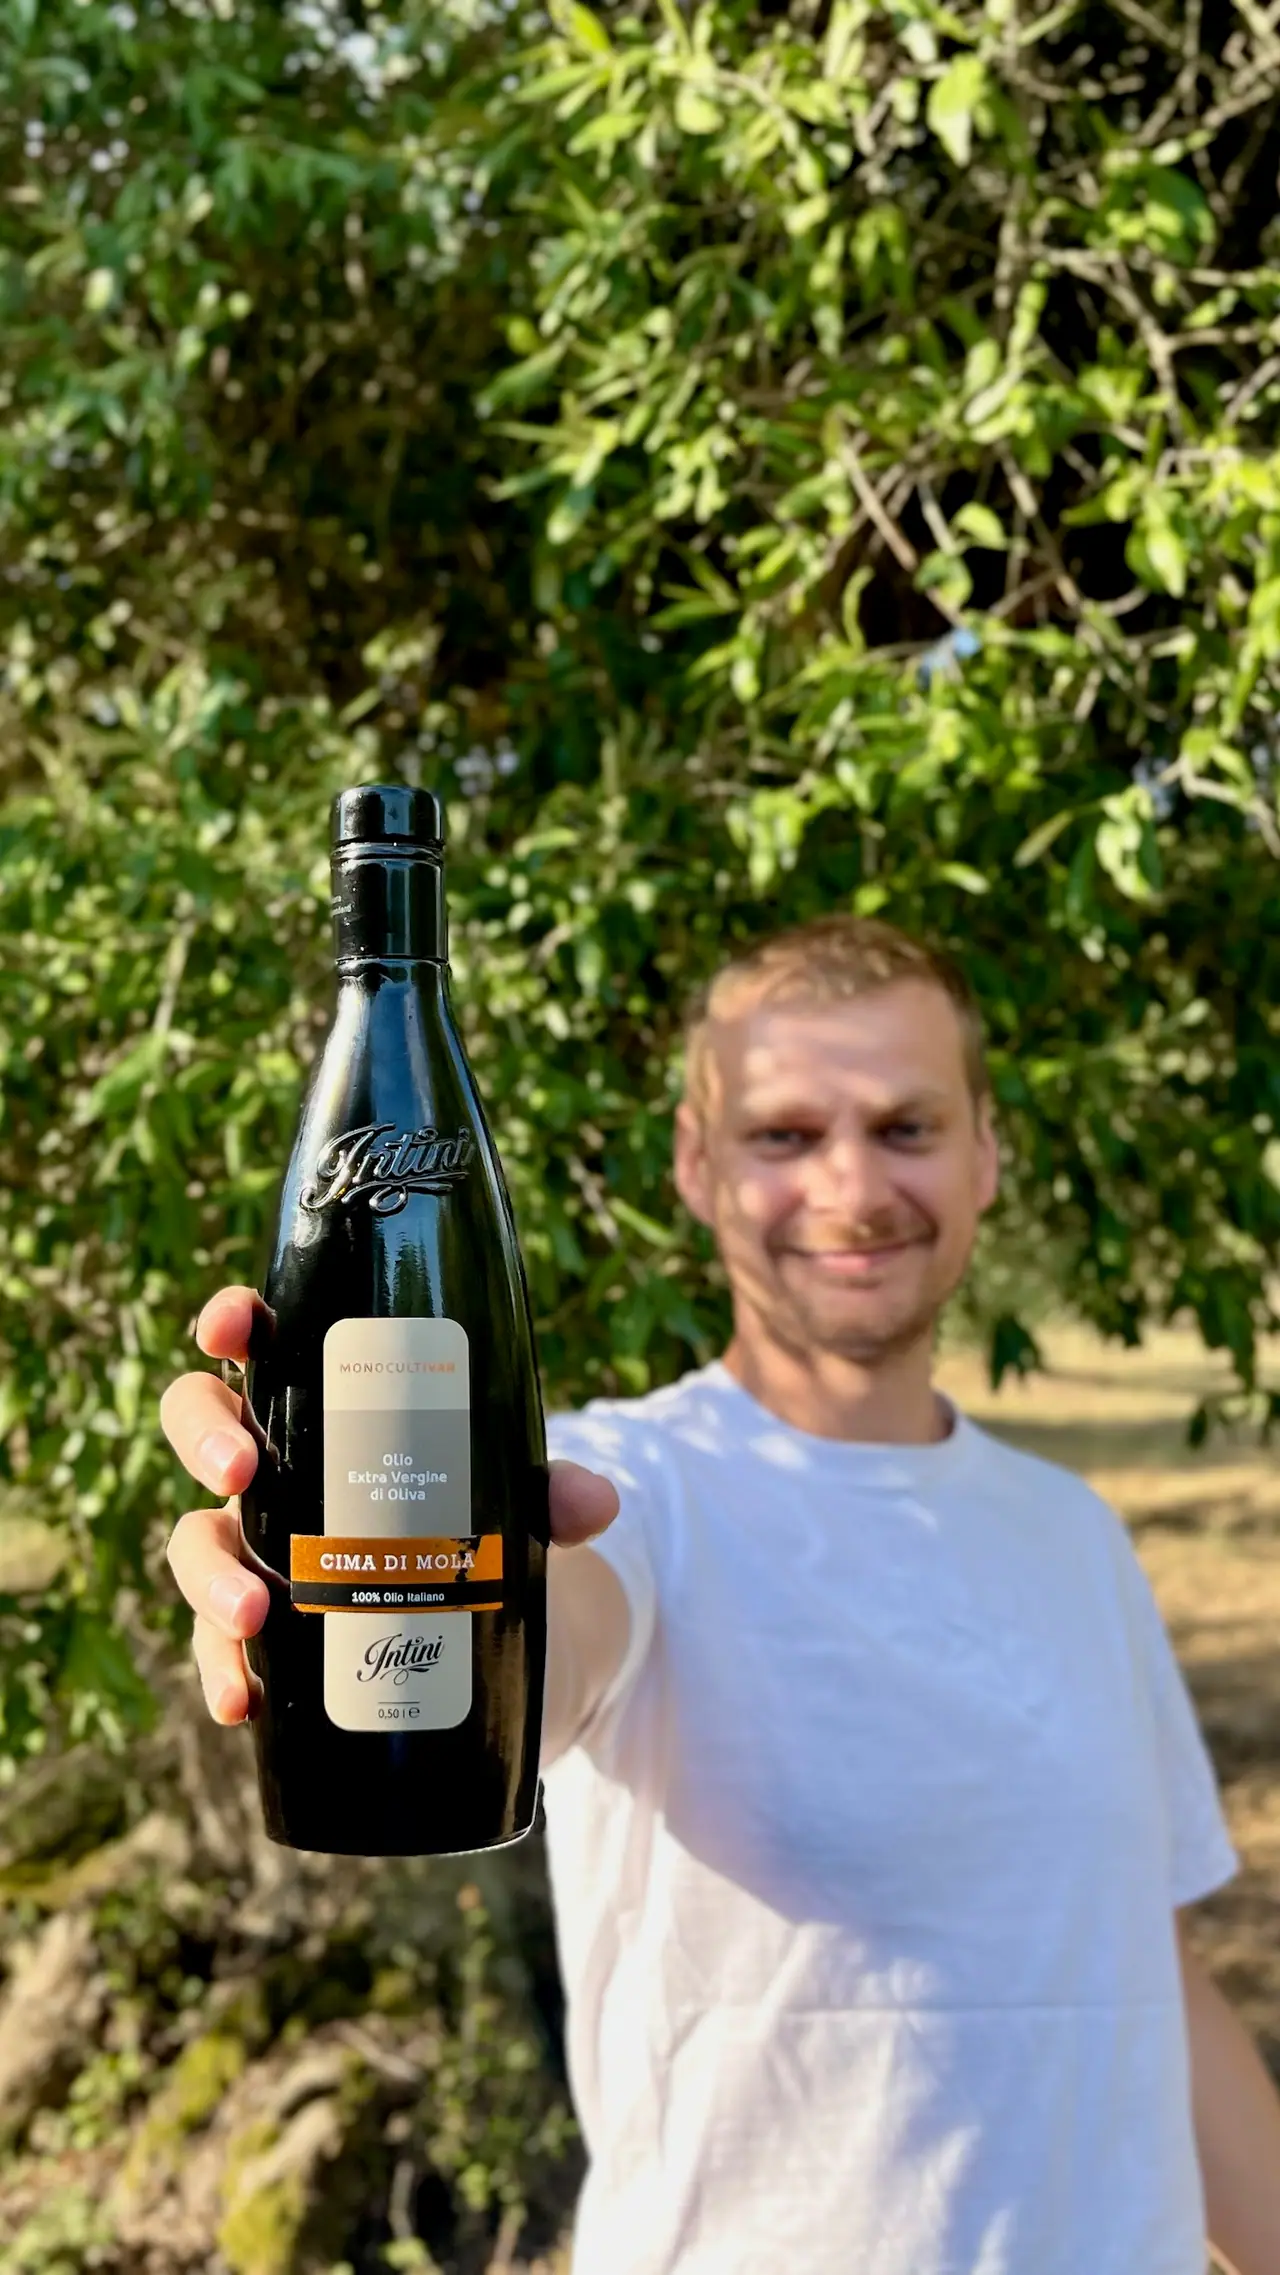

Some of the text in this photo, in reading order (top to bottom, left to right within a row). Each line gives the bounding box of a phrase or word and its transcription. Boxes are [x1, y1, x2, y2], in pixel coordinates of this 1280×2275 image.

[300, 1122, 476, 1213] Intini
[382, 1453, 413, 1467] Olio
[347, 1471, 448, 1486] Extra Vergine
[370, 1488, 426, 1501] di Oliva
[319, 1552, 476, 1571] CIMA DI MOLA
[351, 1591, 445, 1603] 100% Olio Italiano
[356, 1633, 445, 1686] Intini
[378, 1708, 400, 1720] 0,50
